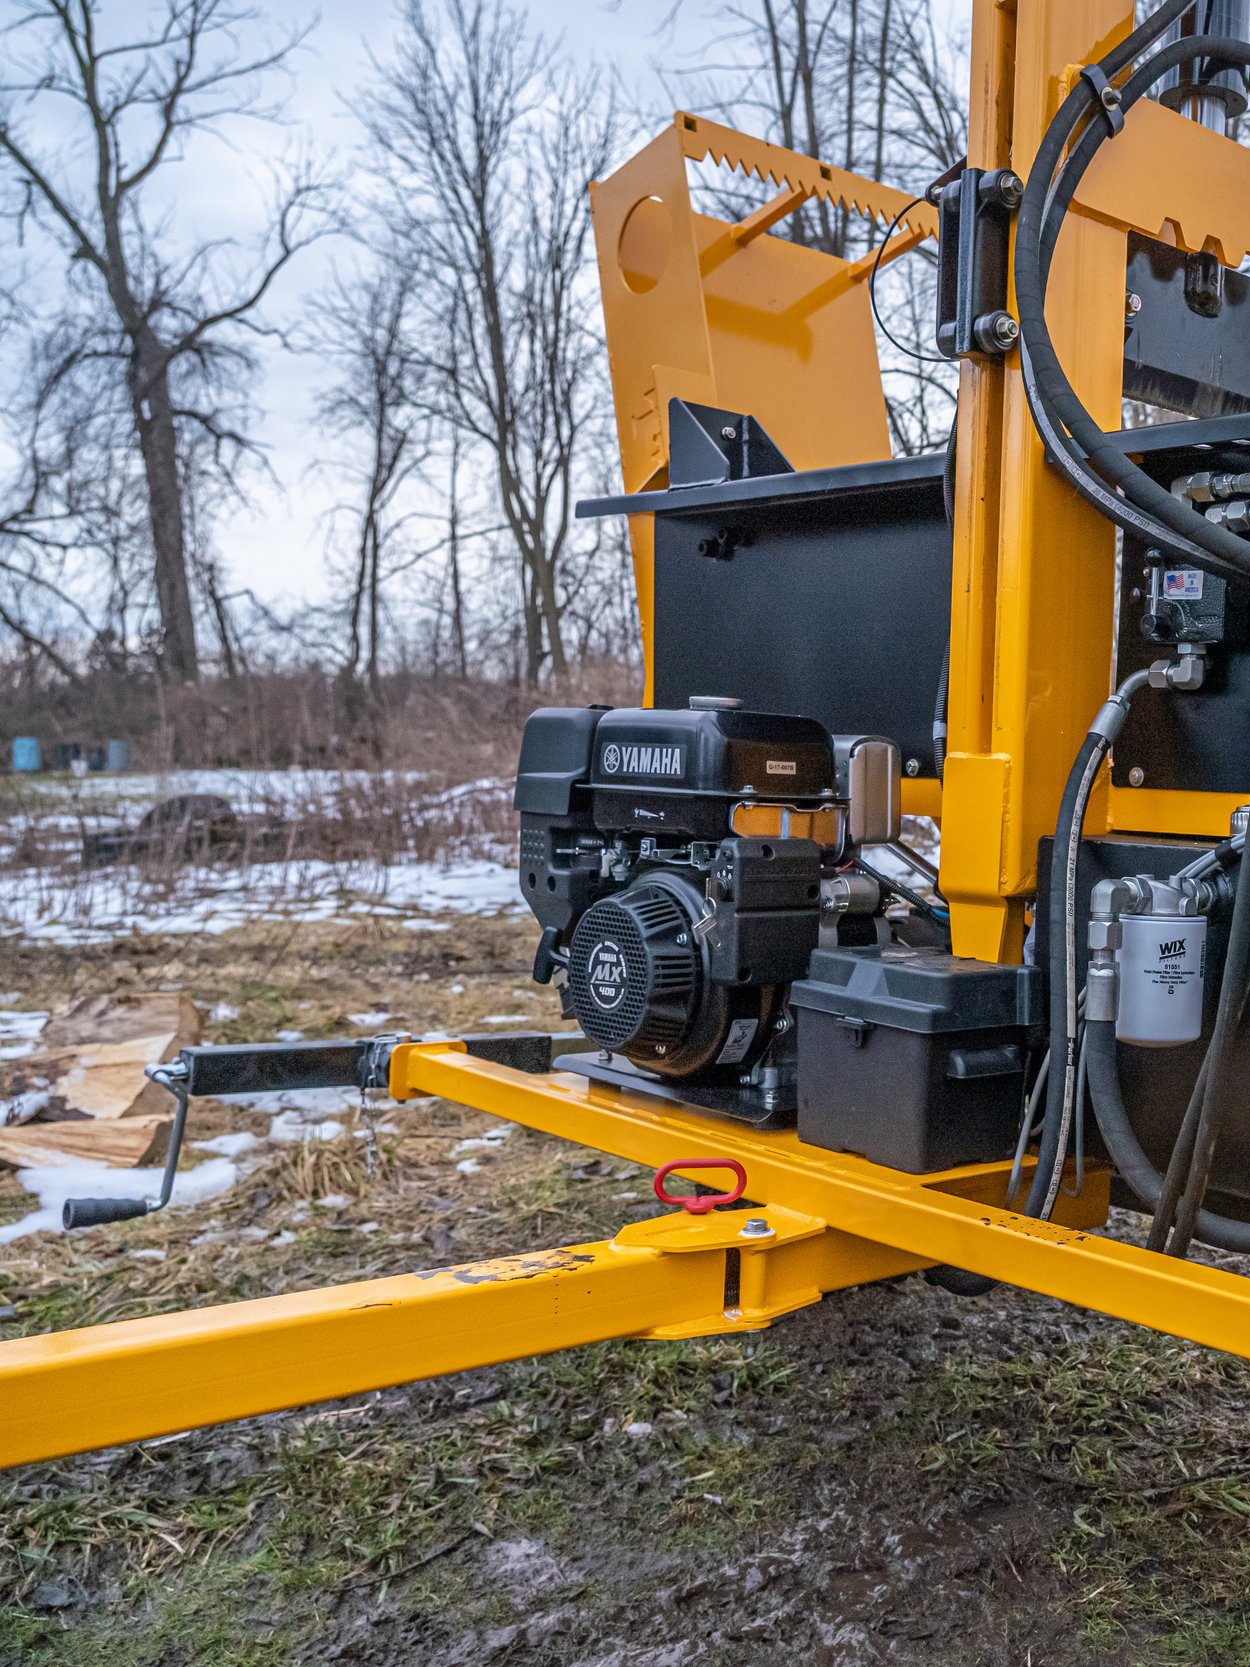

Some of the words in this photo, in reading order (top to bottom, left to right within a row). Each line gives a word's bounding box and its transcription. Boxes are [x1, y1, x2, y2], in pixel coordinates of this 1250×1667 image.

[1100, 493, 1114, 506] MPa
[1114, 503, 1134, 519] (4000
[1134, 514, 1150, 529] PSI)
[622, 746, 681, 775] YAMAHA
[1068, 857, 1075, 865] 21
[1159, 938, 1187, 955] WIX
[599, 986, 616, 997] 400
